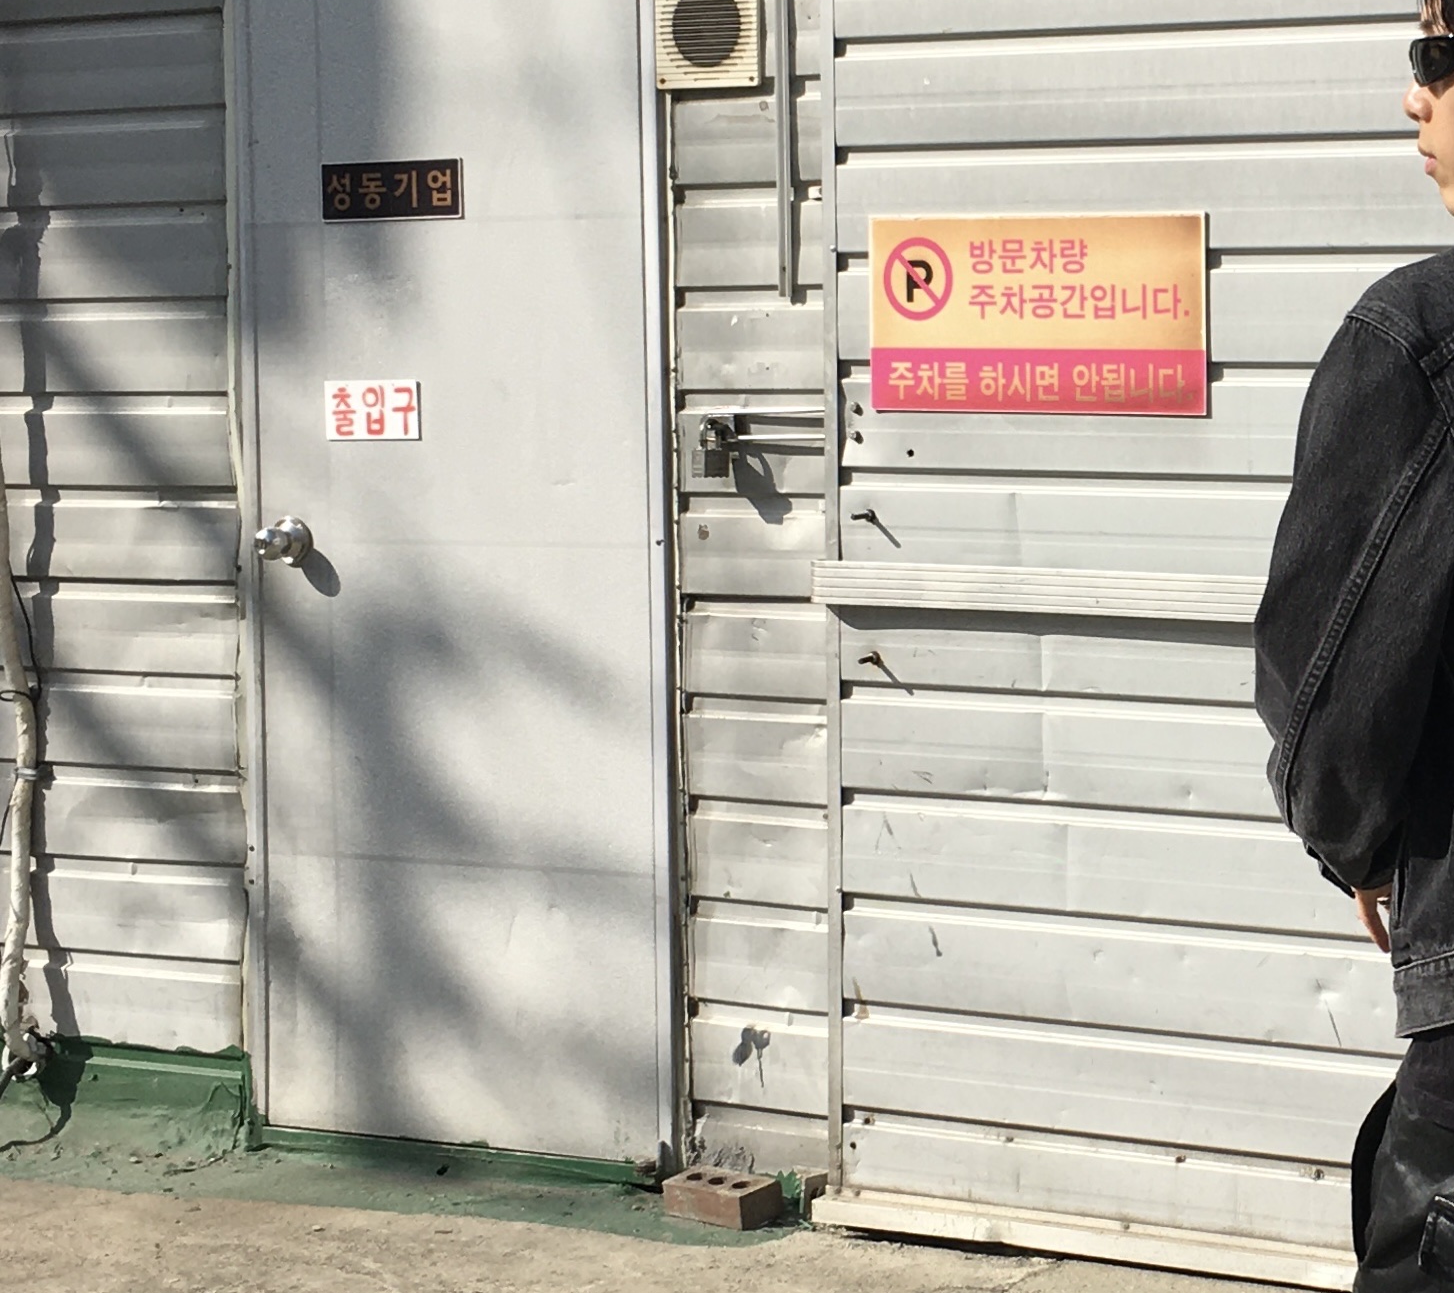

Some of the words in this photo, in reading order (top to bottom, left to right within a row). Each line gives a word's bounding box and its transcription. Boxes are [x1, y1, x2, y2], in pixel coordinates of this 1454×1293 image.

[327, 168, 452, 211] 성동기업
[968, 238, 1088, 274] 방문차량
[968, 283, 1190, 320] 주차공간입니다.
[888, 361, 970, 400] 주차를
[979, 362, 1060, 402] 하시면
[1072, 363, 1194, 404] 안됩니다.
[331, 385, 416, 436] 출입구
